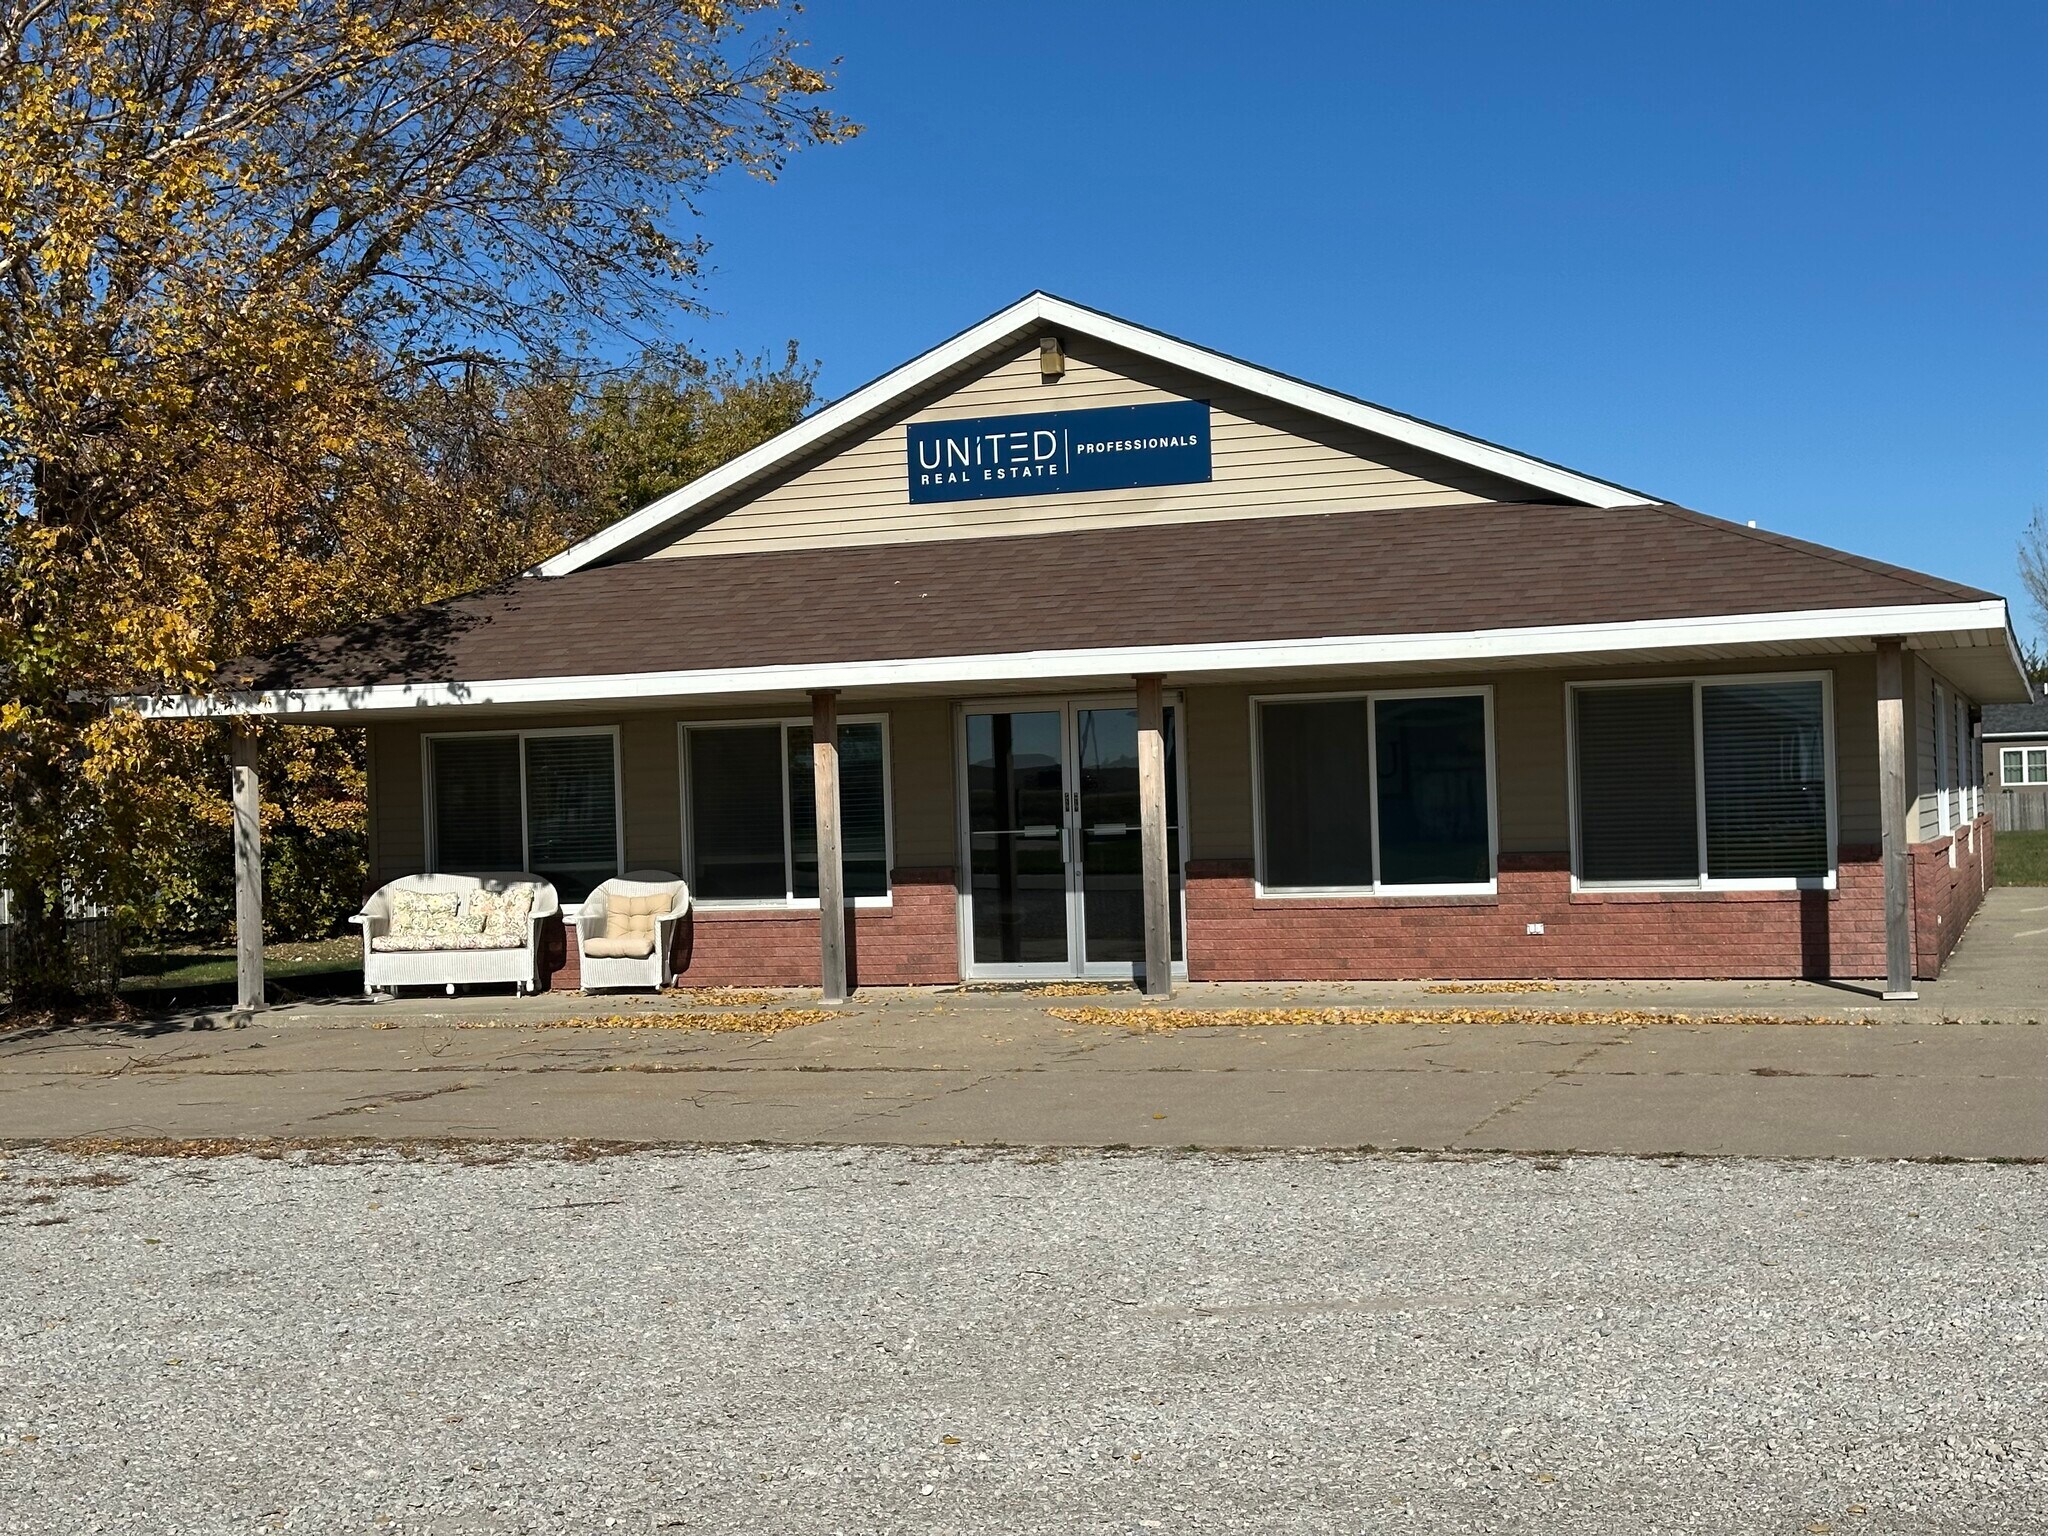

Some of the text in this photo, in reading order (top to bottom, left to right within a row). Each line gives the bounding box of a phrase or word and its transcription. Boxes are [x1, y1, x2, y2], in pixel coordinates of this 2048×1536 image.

[1077, 435, 1198, 455] PROFESSIONALS
[921, 464, 1058, 485] REAL ESTATE
